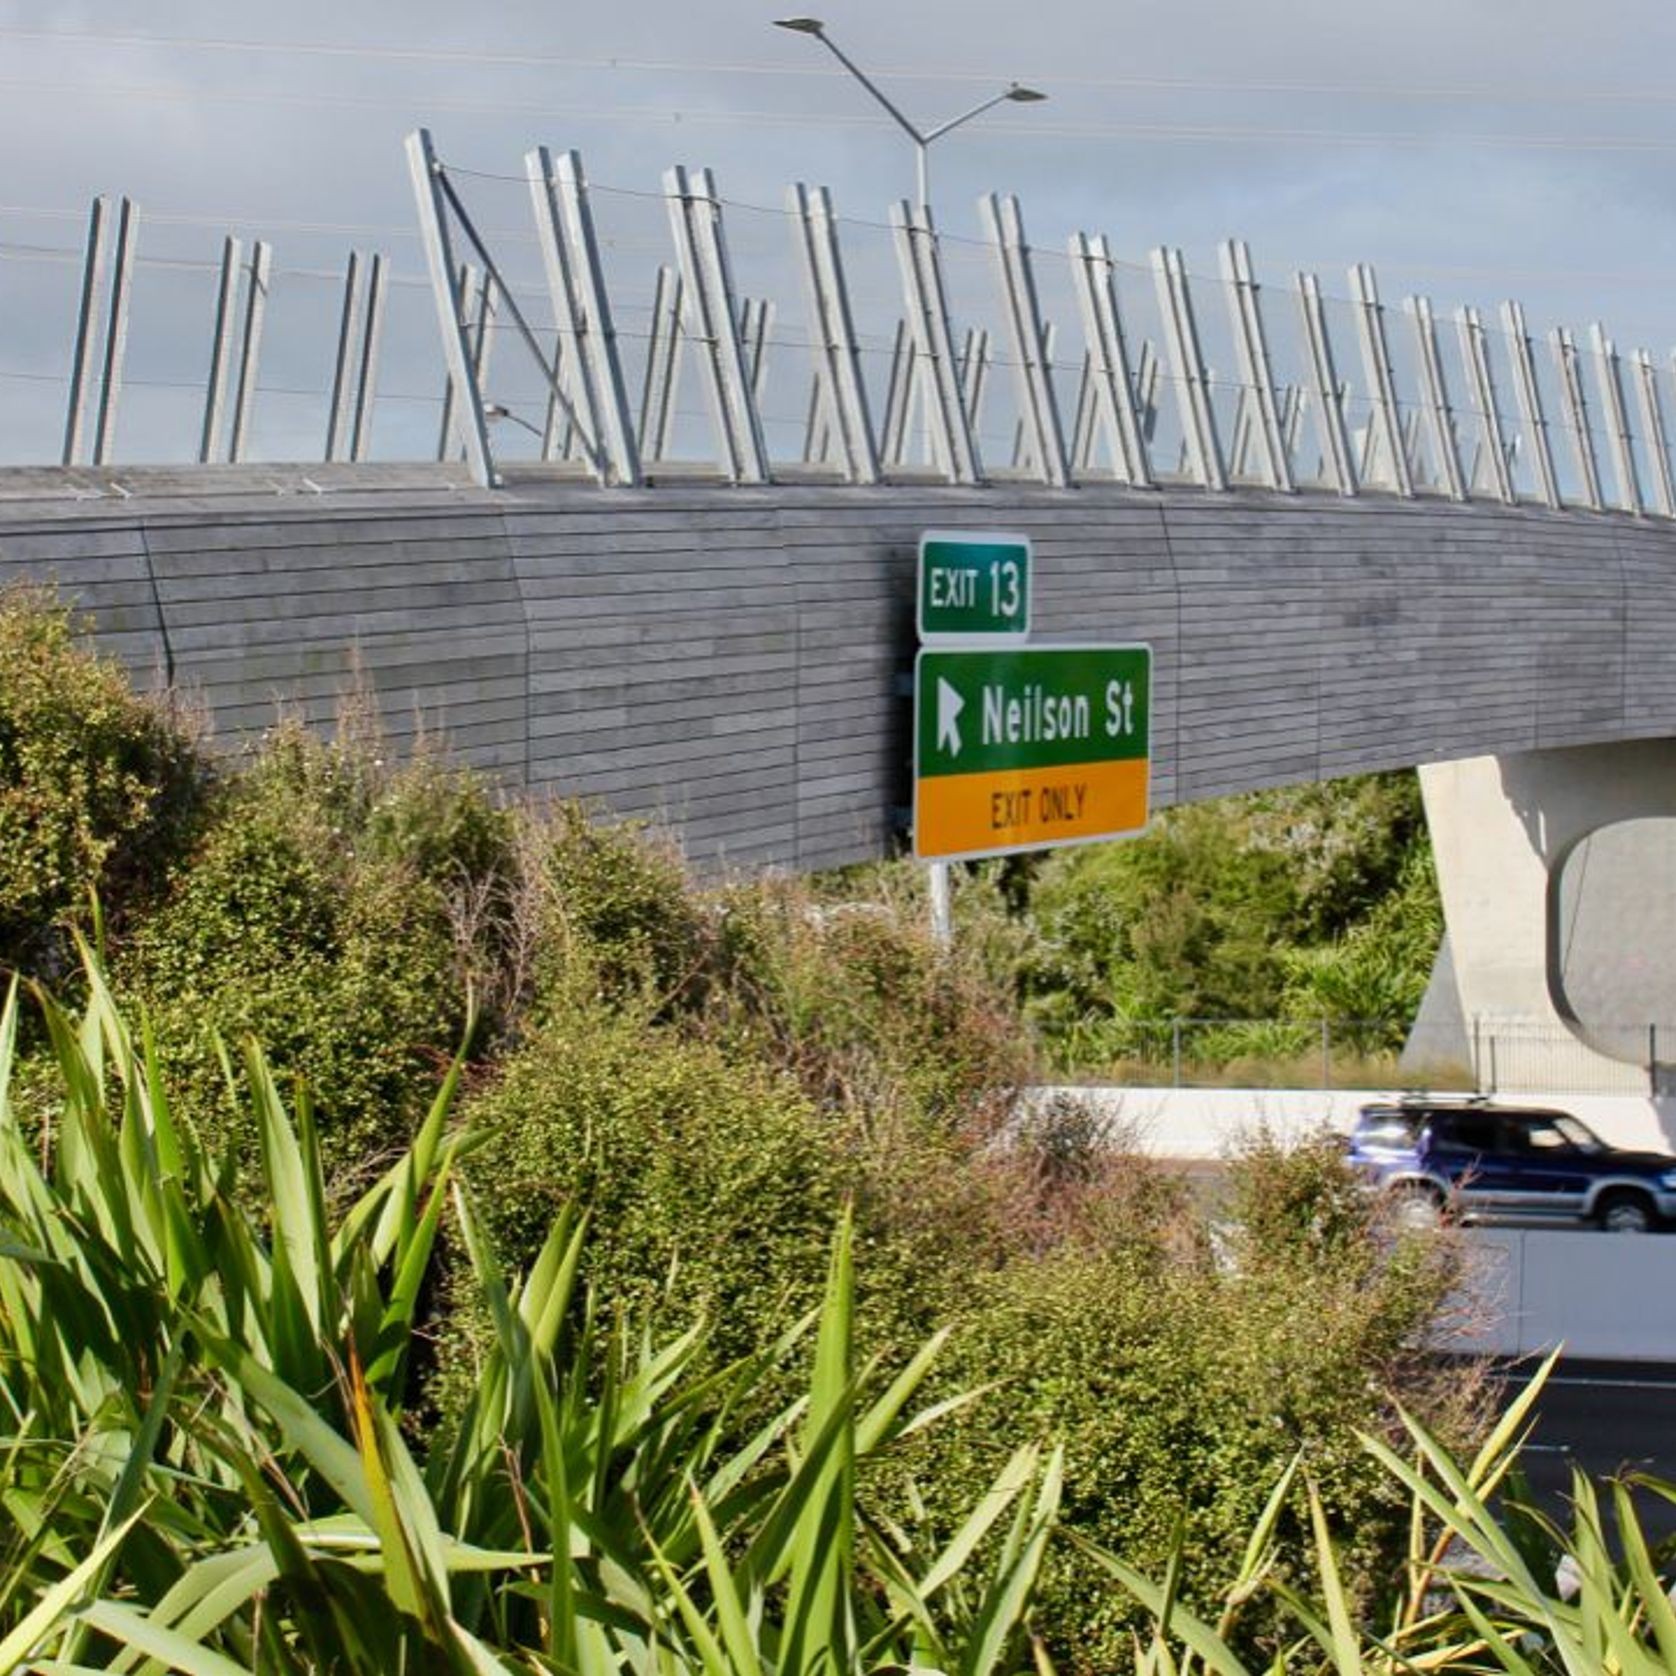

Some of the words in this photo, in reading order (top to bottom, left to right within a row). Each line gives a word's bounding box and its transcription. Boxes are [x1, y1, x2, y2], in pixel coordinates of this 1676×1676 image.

[930, 568, 979, 607] EXIT
[990, 561, 1020, 617] 13
[983, 685, 1089, 745] Neilson
[1105, 680, 1134, 736] St
[992, 789, 1031, 830] EXIT
[1040, 784, 1087, 822] ONLY
